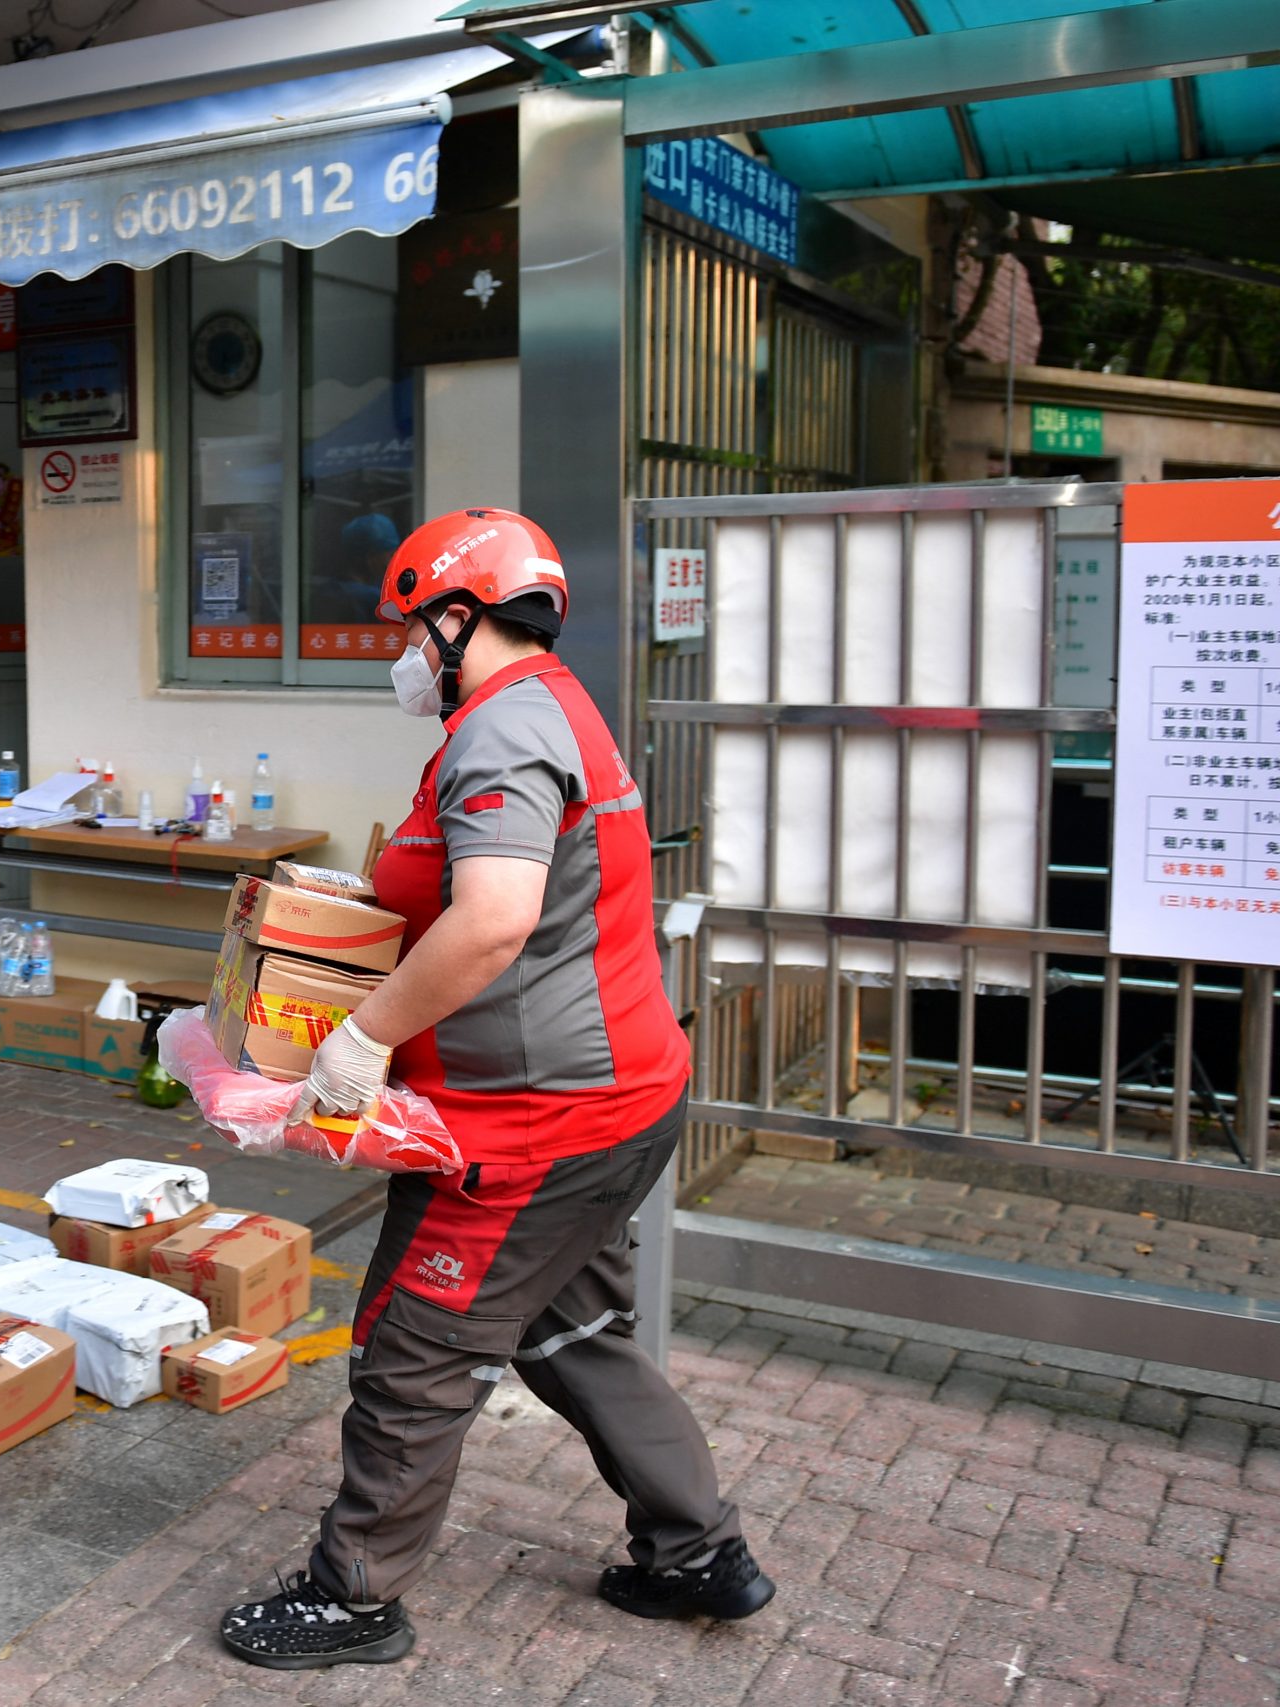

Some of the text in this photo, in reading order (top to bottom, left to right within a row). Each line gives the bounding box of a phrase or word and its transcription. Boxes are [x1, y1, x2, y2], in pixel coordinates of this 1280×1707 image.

[112, 160, 355, 240] 66092112
[431, 551, 460, 580] JDL
[1183, 554, 1280, 569] 为规范本小区
[196, 632, 280, 648] 牢记使命
[310, 633, 401, 650] 心系安全
[1168, 630, 1280, 644] (一)业主车辆地
[291, 905, 312, 918] 京东
[422, 1251, 465, 1281] JDL
